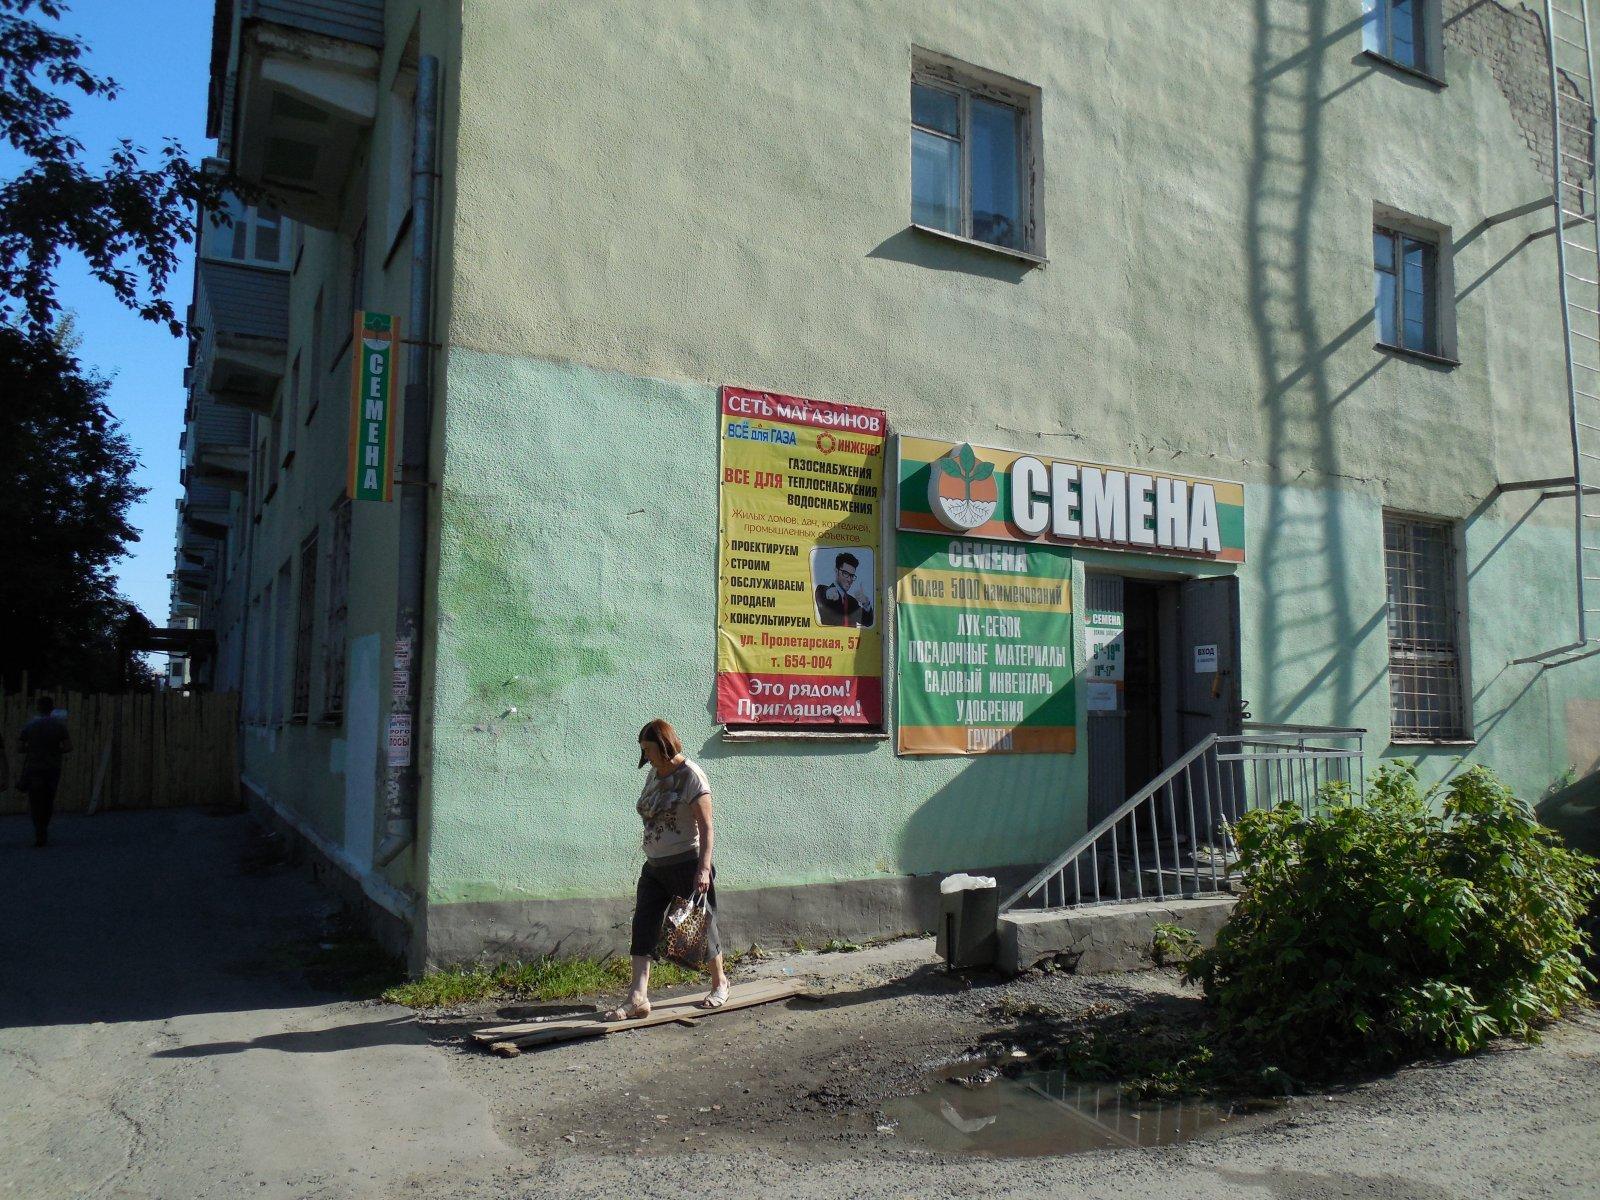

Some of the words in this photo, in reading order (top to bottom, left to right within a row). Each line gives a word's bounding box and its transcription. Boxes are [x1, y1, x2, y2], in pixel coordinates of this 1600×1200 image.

[363, 353, 384, 490] СЕМЕНА
[728, 396, 773, 416] СЕТЬ
[777, 403, 880, 432] МАГАЗИНОВ
[728, 421, 749, 439] ВСЁ
[751, 429, 768, 441] для
[770, 428, 797, 446] ГАЗА
[838, 439, 880, 457] ИНЖЕНЕР
[724, 468, 750, 485] ВСЕ
[754, 471, 783, 489] ДЛЯ
[788, 458, 872, 480] ГАЗОСНАБЖЕНИЯ
[788, 475, 878, 498] ТЕПЛОСНАБЖЕНИЯ
[731, 508, 765, 521] Жилых
[787, 494, 873, 515] ВОДОСНАБЖЕНИЯ
[1010, 455, 1221, 552] СЕМЕНА
[744, 523, 816, 538] промышленных
[818, 530, 861, 543] объектов
[731, 540, 799, 556] ПРОЕКТИРУЕМ
[948, 540, 1028, 573] СЕМЕНА
[730, 558, 770, 571] СТРОИМ
[730, 576, 805, 592] ОБСЛУЖИВАЕМ
[911, 574, 945, 598] более
[951, 577, 980, 601] 5000
[983, 582, 1062, 606] наименований
[730, 594, 776, 609] ПРОДАЕМ
[730, 612, 811, 628] КОНСУЛЬТИРУЕМ
[957, 613, 1021, 638] ЛУК-СЕВОК
[1092, 613, 1121, 627] СЕМЕНА
[740, 634, 757, 648] ул.
[761, 632, 844, 651] Пролетарская,
[848, 636, 861, 650] 57
[1197, 647, 1215, 656] ВХОД
[771, 656, 780, 668] т.
[784, 655, 833, 670] 654-004
[908, 640, 988, 667] ПОСАДОЧНЫЕ
[995, 643, 1066, 668] МАТЕРИАЛЫ
[748, 678, 785, 697] Это
[789, 680, 851, 700] рядом!
[924, 668, 982, 696] САДОВЫЙ
[989, 673, 1053, 694] ИНВЕНТАРЬ
[737, 698, 862, 720] Приглашаем!
[956, 699, 1024, 725] УДОБРЕНИЯ
[967, 728, 1013, 751] ГРУНТЫ
